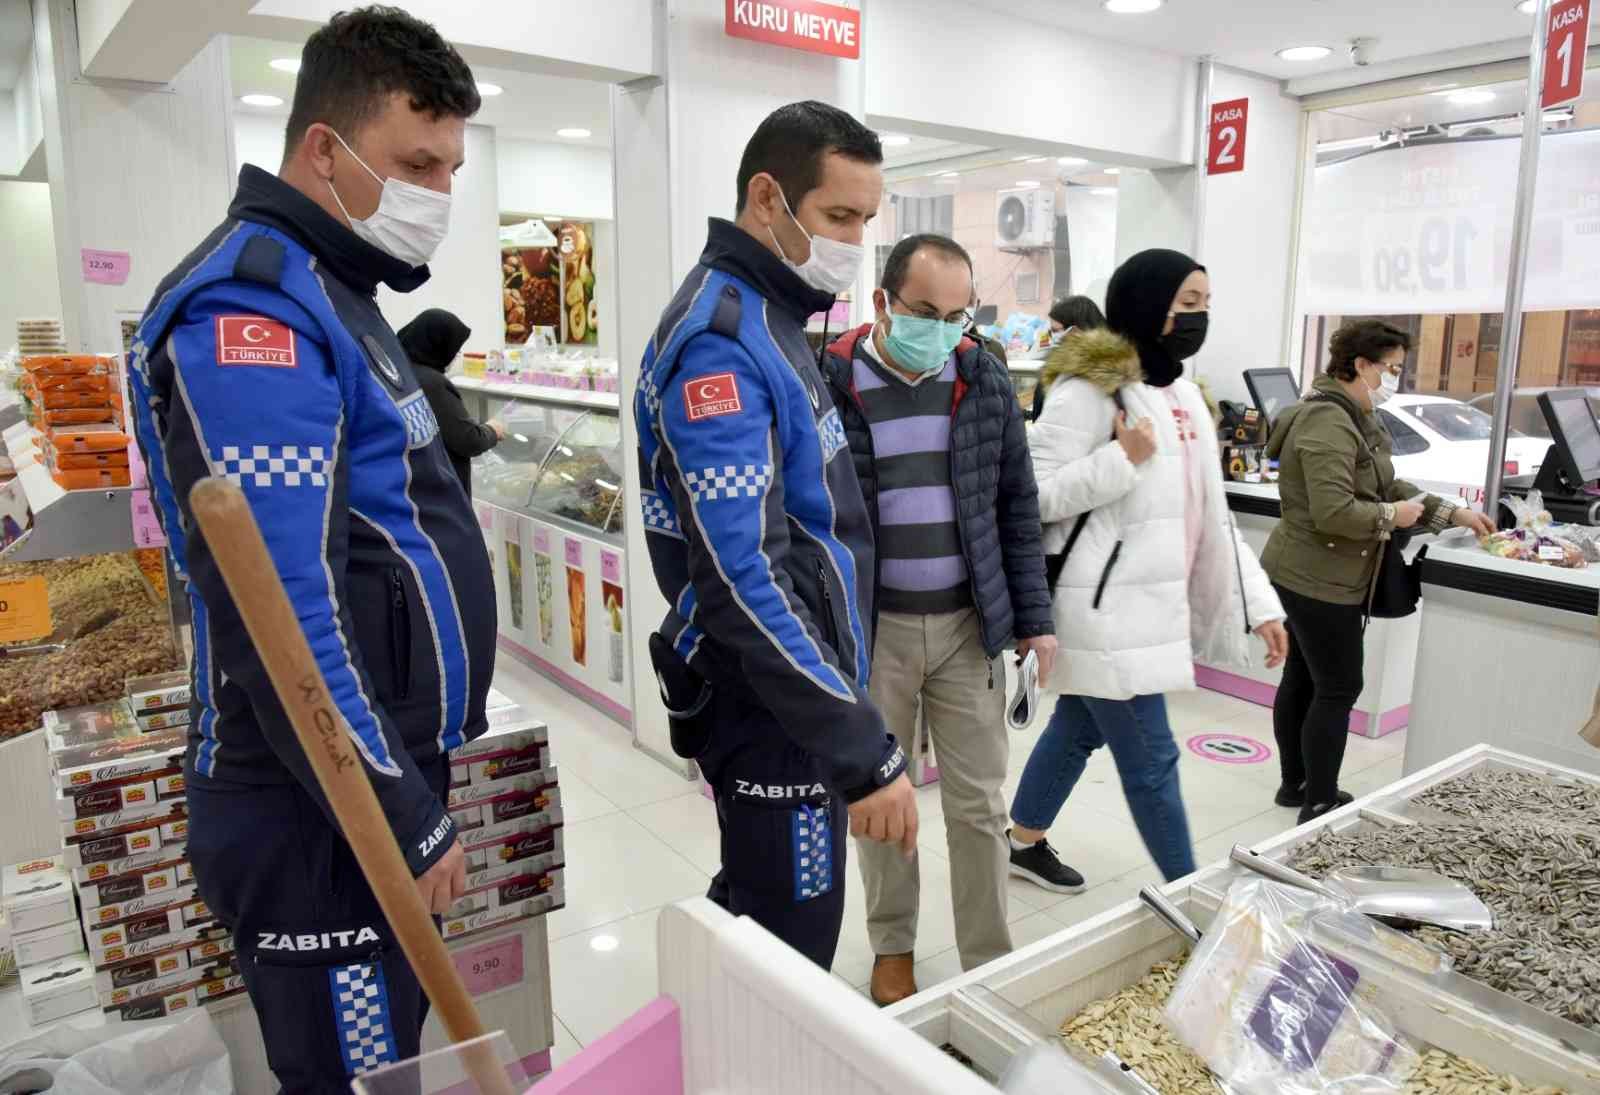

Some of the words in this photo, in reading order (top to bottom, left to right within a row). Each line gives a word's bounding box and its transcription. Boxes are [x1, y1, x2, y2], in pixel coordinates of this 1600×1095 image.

[734, 0, 788, 32] KURU
[793, 10, 856, 46] MEYVE
[1551, 3, 1583, 32] KASA
[1556, 32, 1574, 88] 1
[1214, 107, 1243, 124] KASA
[1215, 126, 1238, 165] 2
[228, 348, 289, 362] TÜRKİYE
[735, 779, 827, 799] ZABITA
[257, 926, 380, 951] ZABITA
